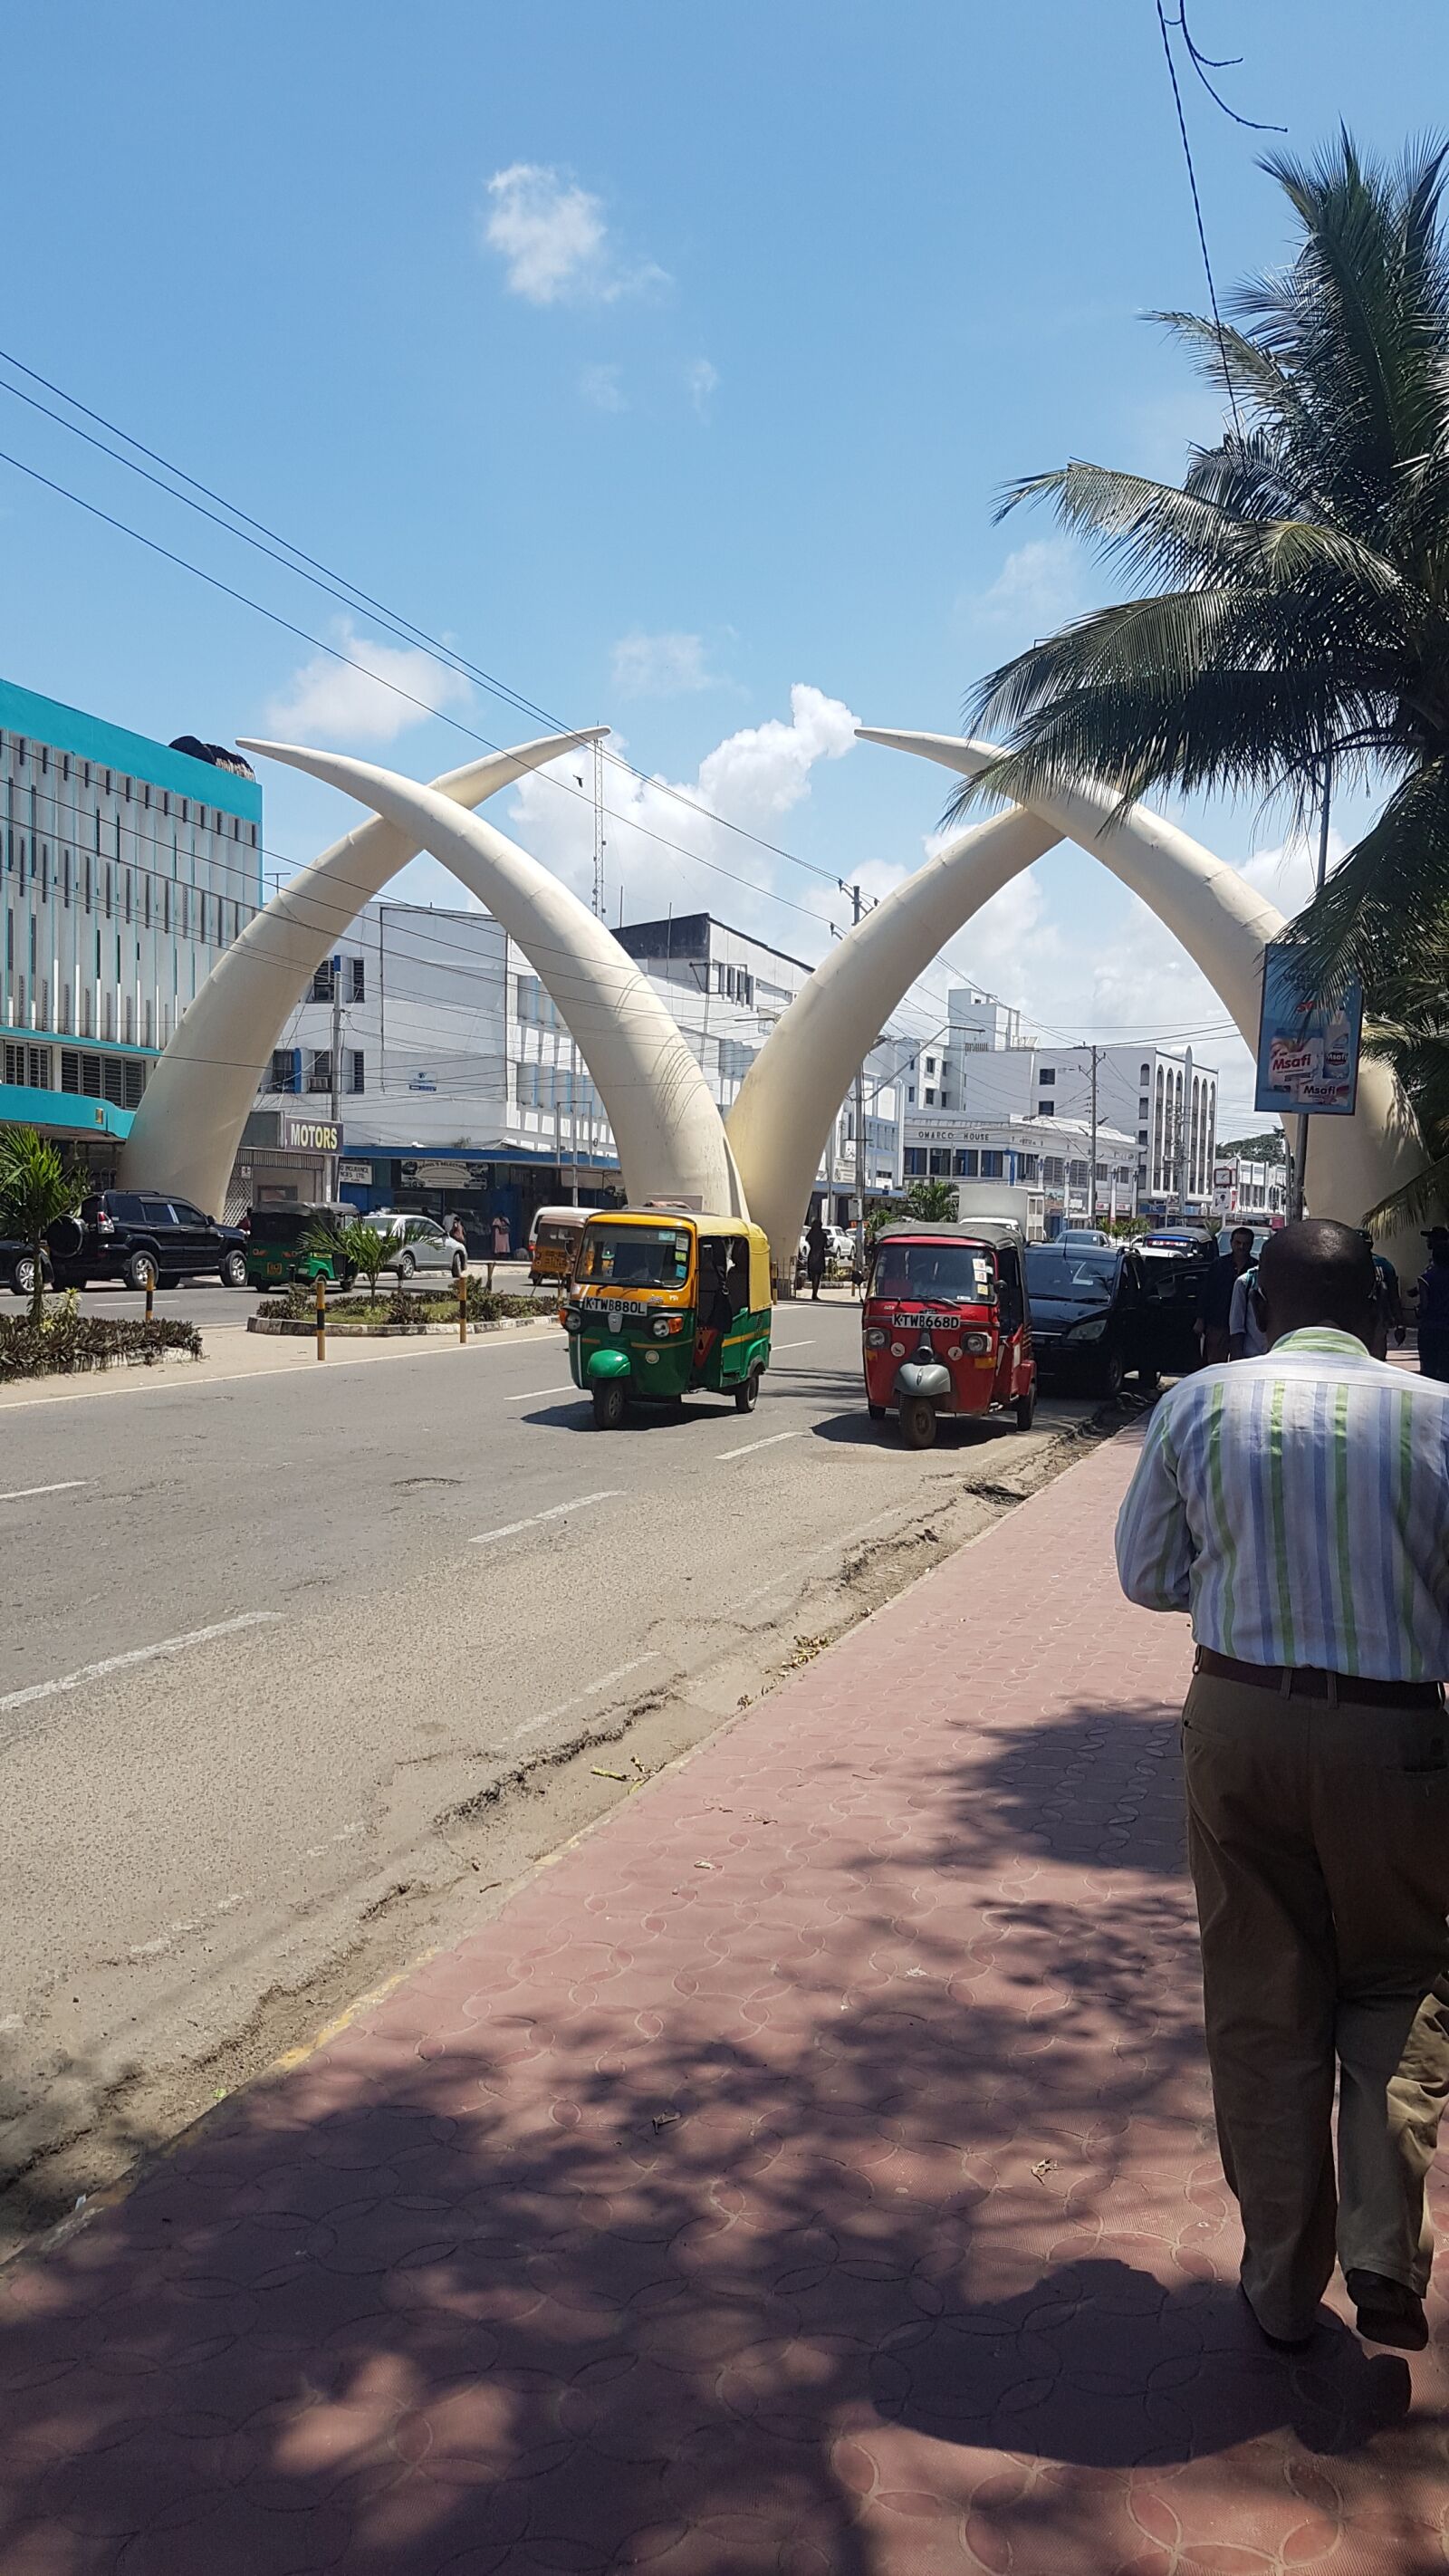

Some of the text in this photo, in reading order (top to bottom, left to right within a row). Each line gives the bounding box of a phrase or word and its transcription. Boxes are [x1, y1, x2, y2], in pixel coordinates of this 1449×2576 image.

[1272, 1053, 1311, 1071] Msafi
[1304, 1085, 1335, 1095] Msafi
[291, 1123, 338, 1149] MOTORS
[964, 1132, 990, 1141] HOUSE
